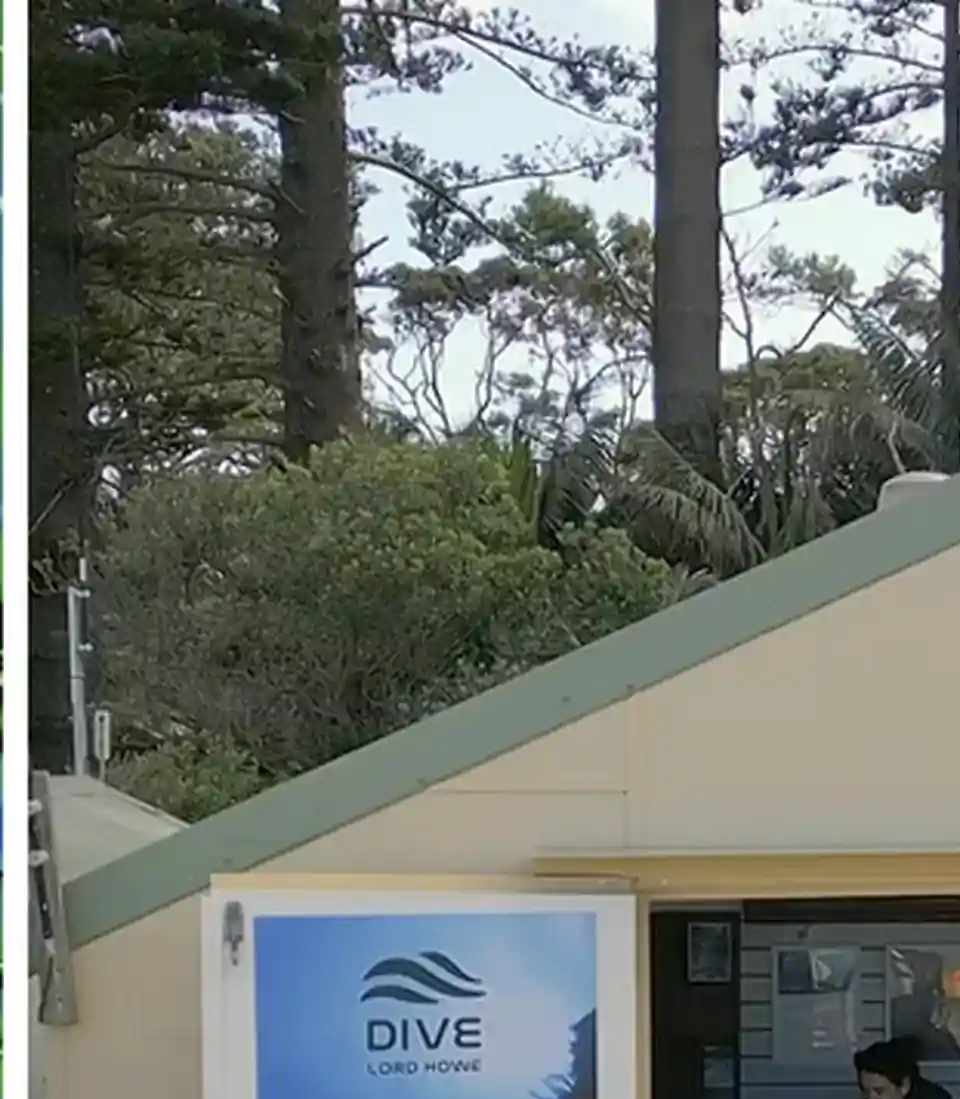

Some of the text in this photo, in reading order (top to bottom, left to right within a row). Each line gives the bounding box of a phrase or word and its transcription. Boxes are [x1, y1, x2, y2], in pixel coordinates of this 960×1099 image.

[366, 1017, 483, 1051] DIVE
[366, 1058, 482, 1077] LORD HOWE
